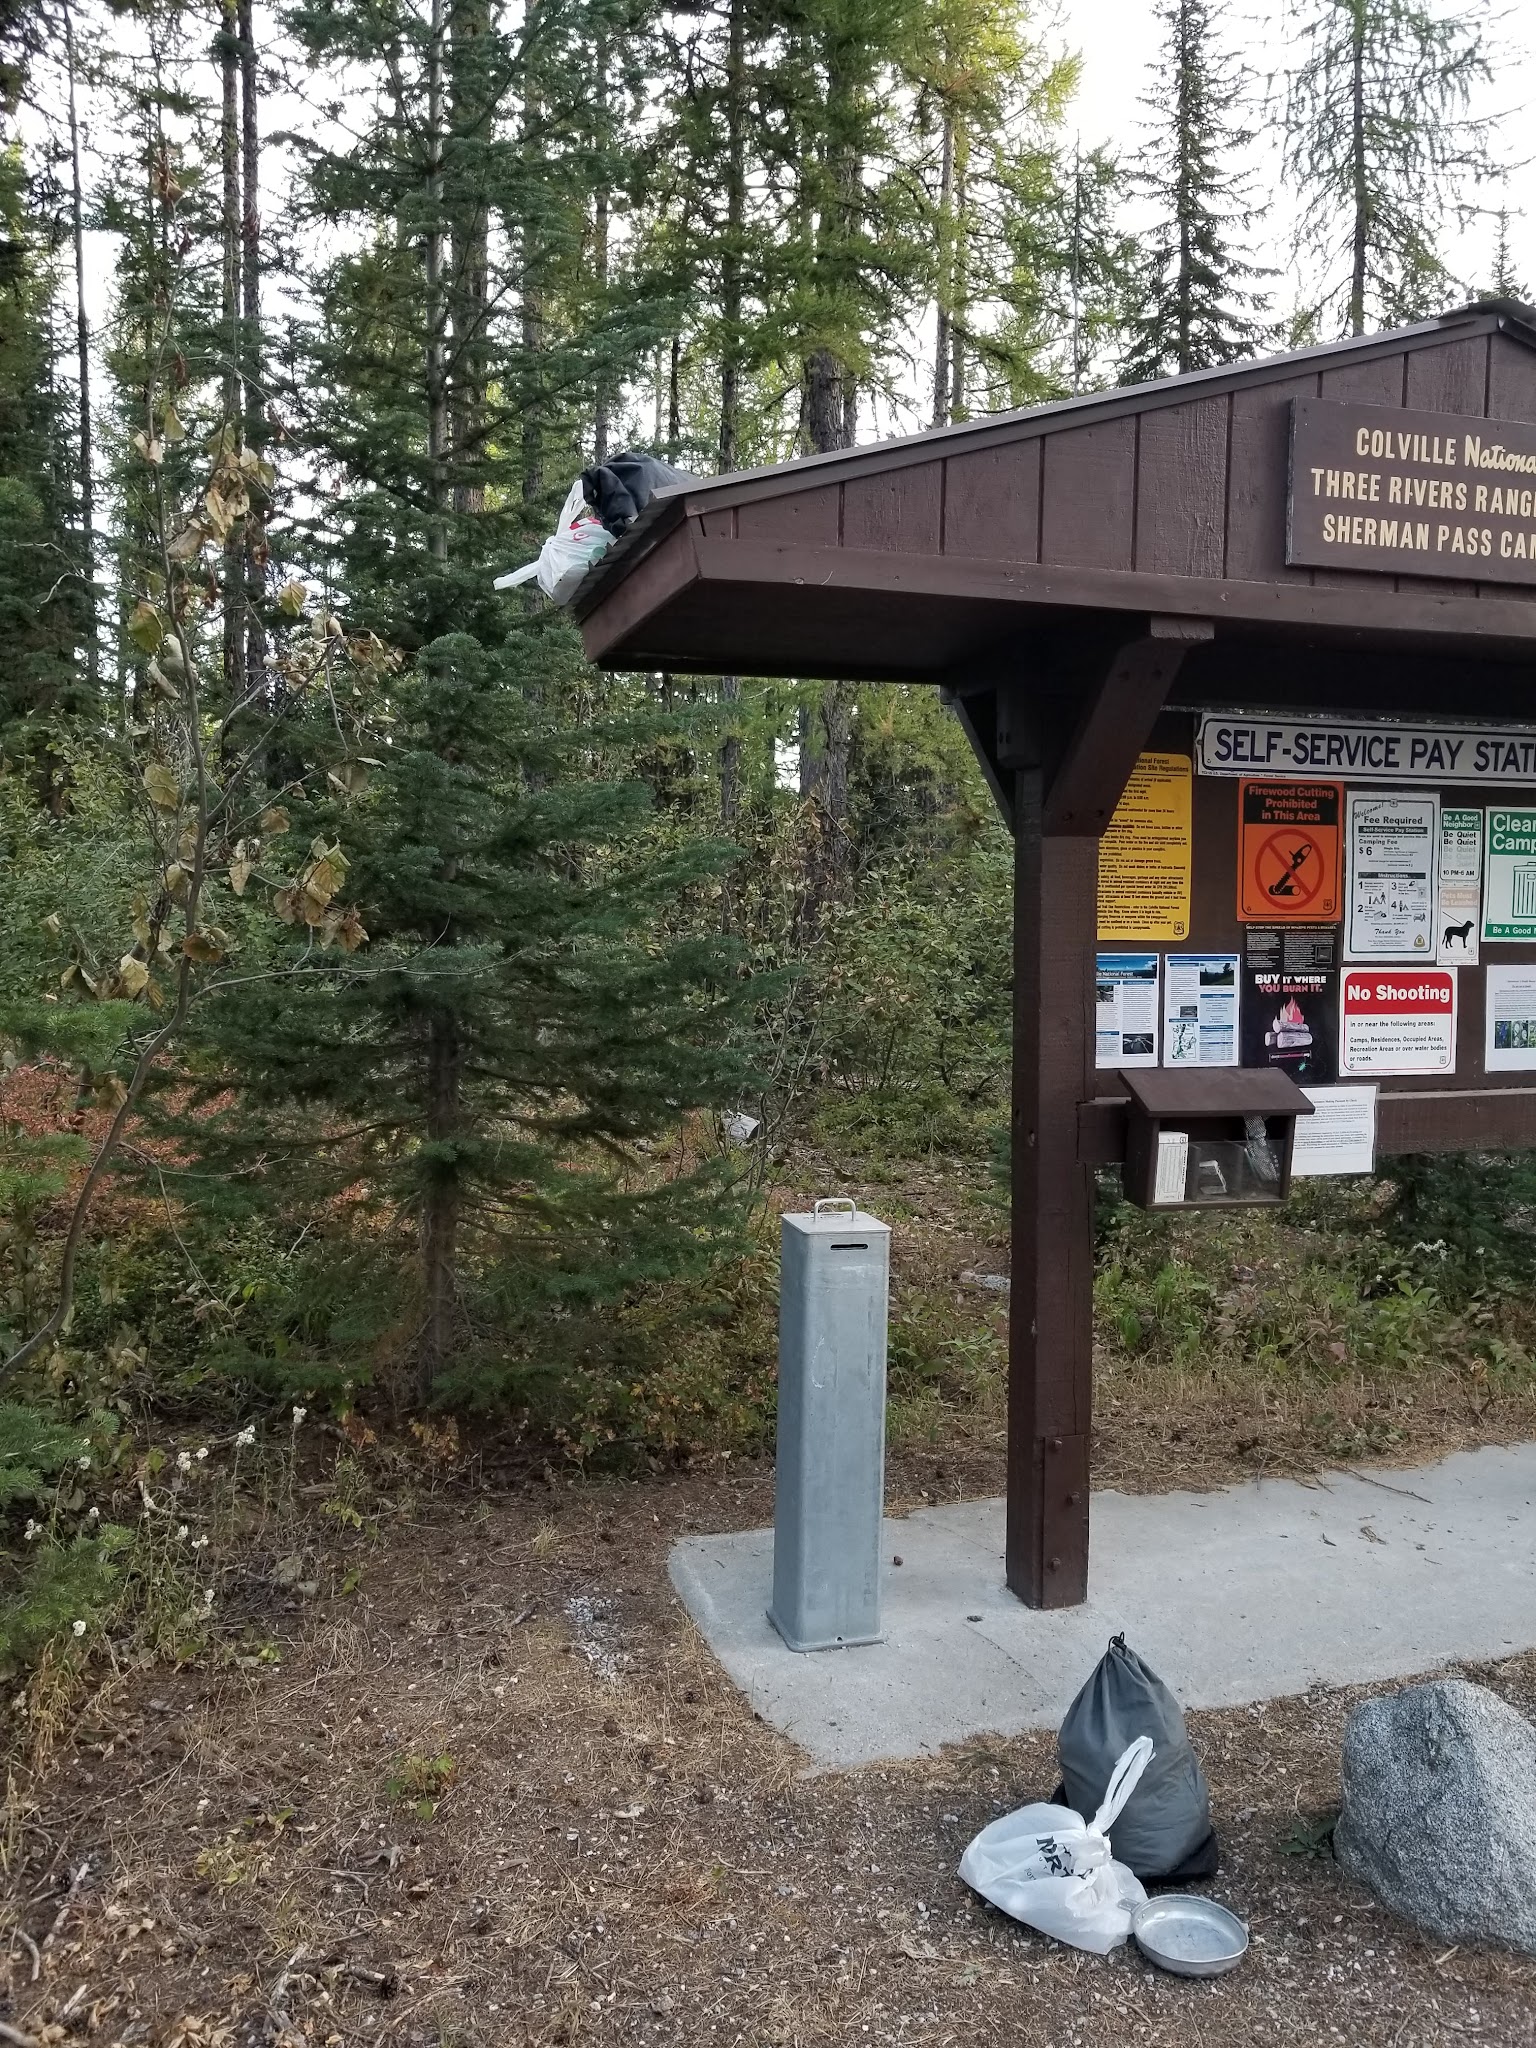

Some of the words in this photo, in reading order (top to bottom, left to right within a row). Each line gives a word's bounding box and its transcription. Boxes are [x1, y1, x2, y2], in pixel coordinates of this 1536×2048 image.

[1356, 427, 1456, 466] COLVILLE
[1311, 468, 1381, 501] THREE
[1389, 476, 1467, 511] RIVERS
[1475, 485, 1536, 518] RANG
[1323, 513, 1430, 550] SHERMAN
[1437, 525, 1492, 557] PASS
[1214, 728, 1401, 768] SELF-SERVICE
[1410, 738, 1465, 770] PAY
[1249, 786, 1295, 797] Firewood
[1297, 787, 1334, 799] Cutting
[1265, 798, 1317, 809] Prohibited
[1262, 810, 1271, 819] in
[1273, 810, 1295, 820] This
[1296, 811, 1321, 821] Area
[1443, 813, 1452, 821] Be
[1454, 813, 1460, 821] A
[1364, 816, 1380, 824] Fee
[1383, 816, 1423, 826] Required
[1443, 820, 1474, 829] Neighbor
[1443, 830, 1453, 838] Be
[1457, 838, 1476, 846] Quiet
[1366, 846, 1373, 856] 6
[1358, 881, 1363, 889] 1
[1391, 881, 1397, 890] 3
[1357, 904, 1364, 912] 2
[1390, 901, 1397, 909] 4
[1492, 926, 1502, 934] Be
[1505, 926, 1510, 934] A
[1512, 926, 1532, 934] Good
[1255, 973, 1280, 984] BUY
[1282, 976, 1292, 984] IT
[1293, 975, 1327, 984] WHERE
[1259, 984, 1280, 993] YOU
[1282, 984, 1308, 993] BURN
[1310, 984, 1323, 993] IT.
[1347, 985, 1371, 1001] No
[1376, 984, 1450, 1004] Shooting
[1390, 1020, 1416, 1028] following
[1370, 1036, 1401, 1044] Residences,
